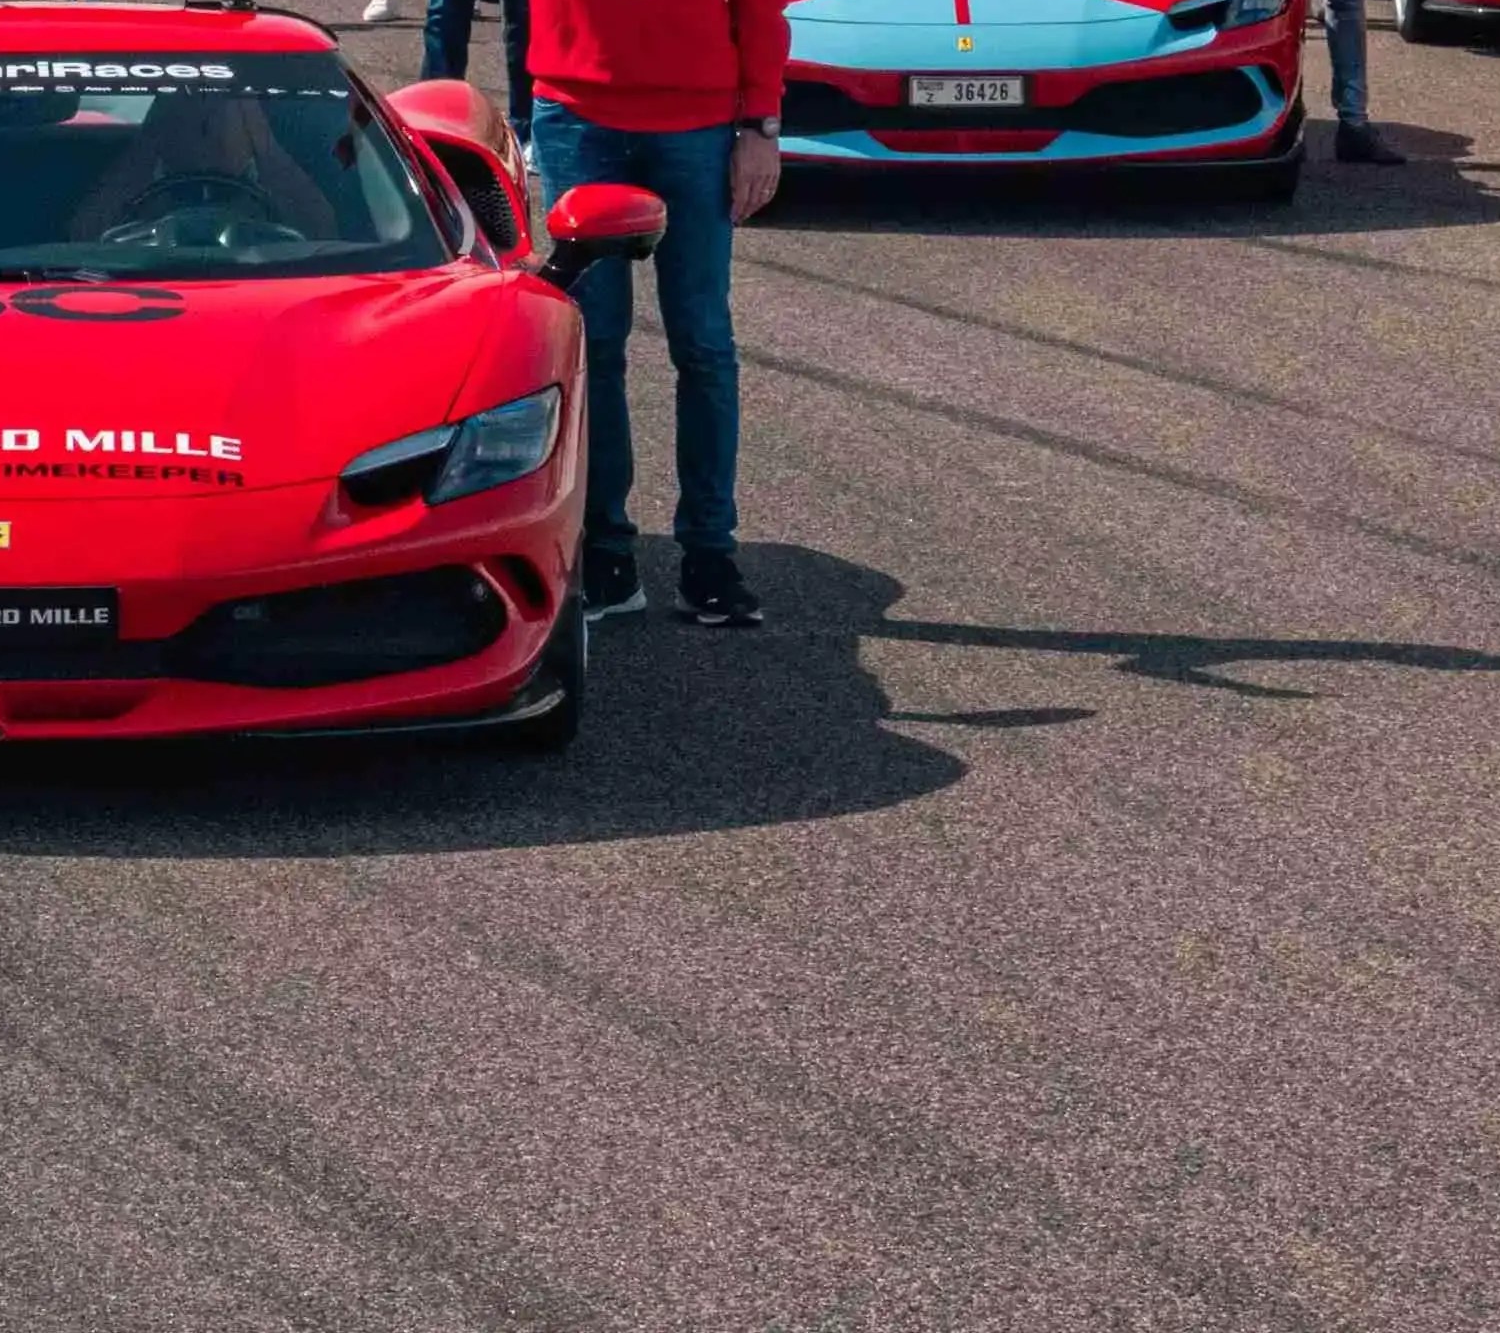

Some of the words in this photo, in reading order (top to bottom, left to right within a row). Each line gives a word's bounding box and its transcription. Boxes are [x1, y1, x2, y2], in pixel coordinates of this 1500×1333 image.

[953, 82, 1009, 102] 36426
[65, 429, 243, 461] MILLE
[30, 606, 110, 625] MILLE
